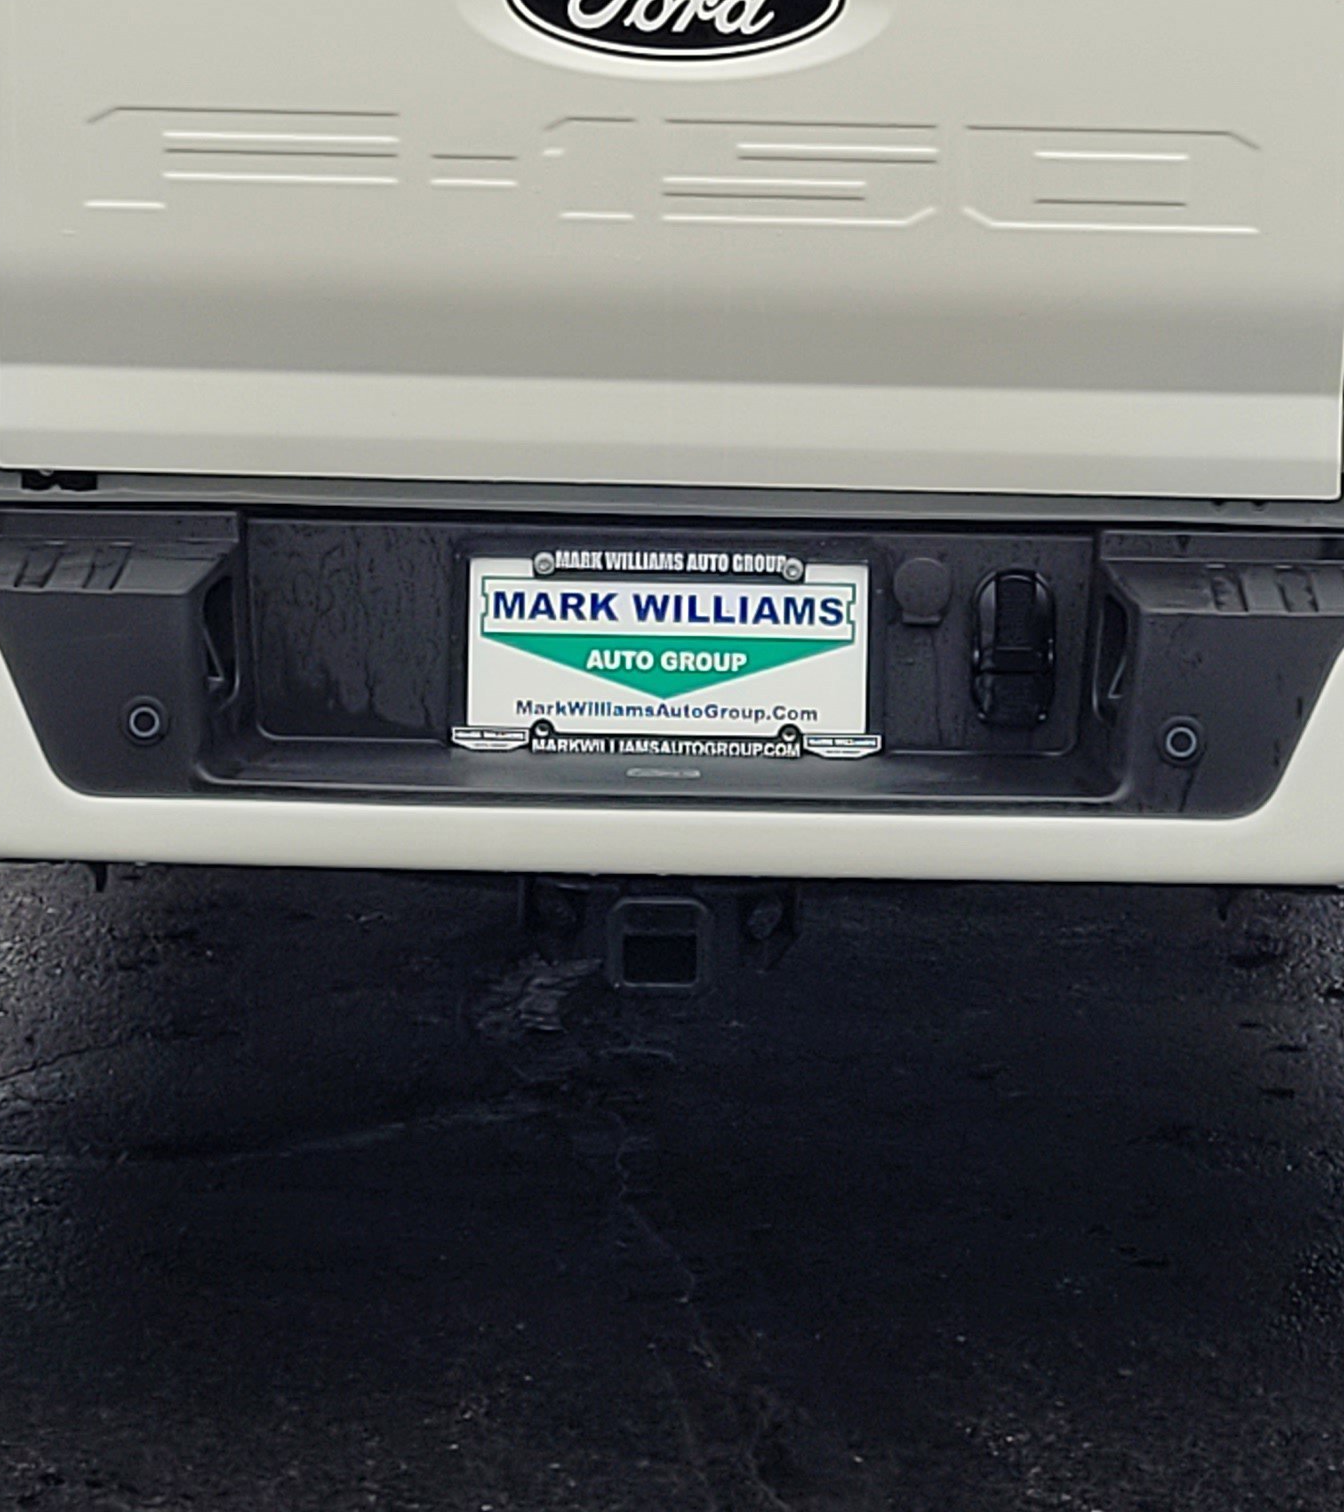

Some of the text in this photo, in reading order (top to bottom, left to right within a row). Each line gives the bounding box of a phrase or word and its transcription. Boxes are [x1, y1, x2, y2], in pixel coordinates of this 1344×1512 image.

[84, 105, 1262, 235] F-150
[556, 550, 603, 570] MARK
[605, 551, 683, 572] WILLIAMS
[686, 552, 729, 572] AUTO
[492, 590, 845, 627] MARK WILLIAMS
[586, 649, 748, 673] AUTO GROUP
[516, 699, 818, 724] MarkWilliamsAutoGroup.Com
